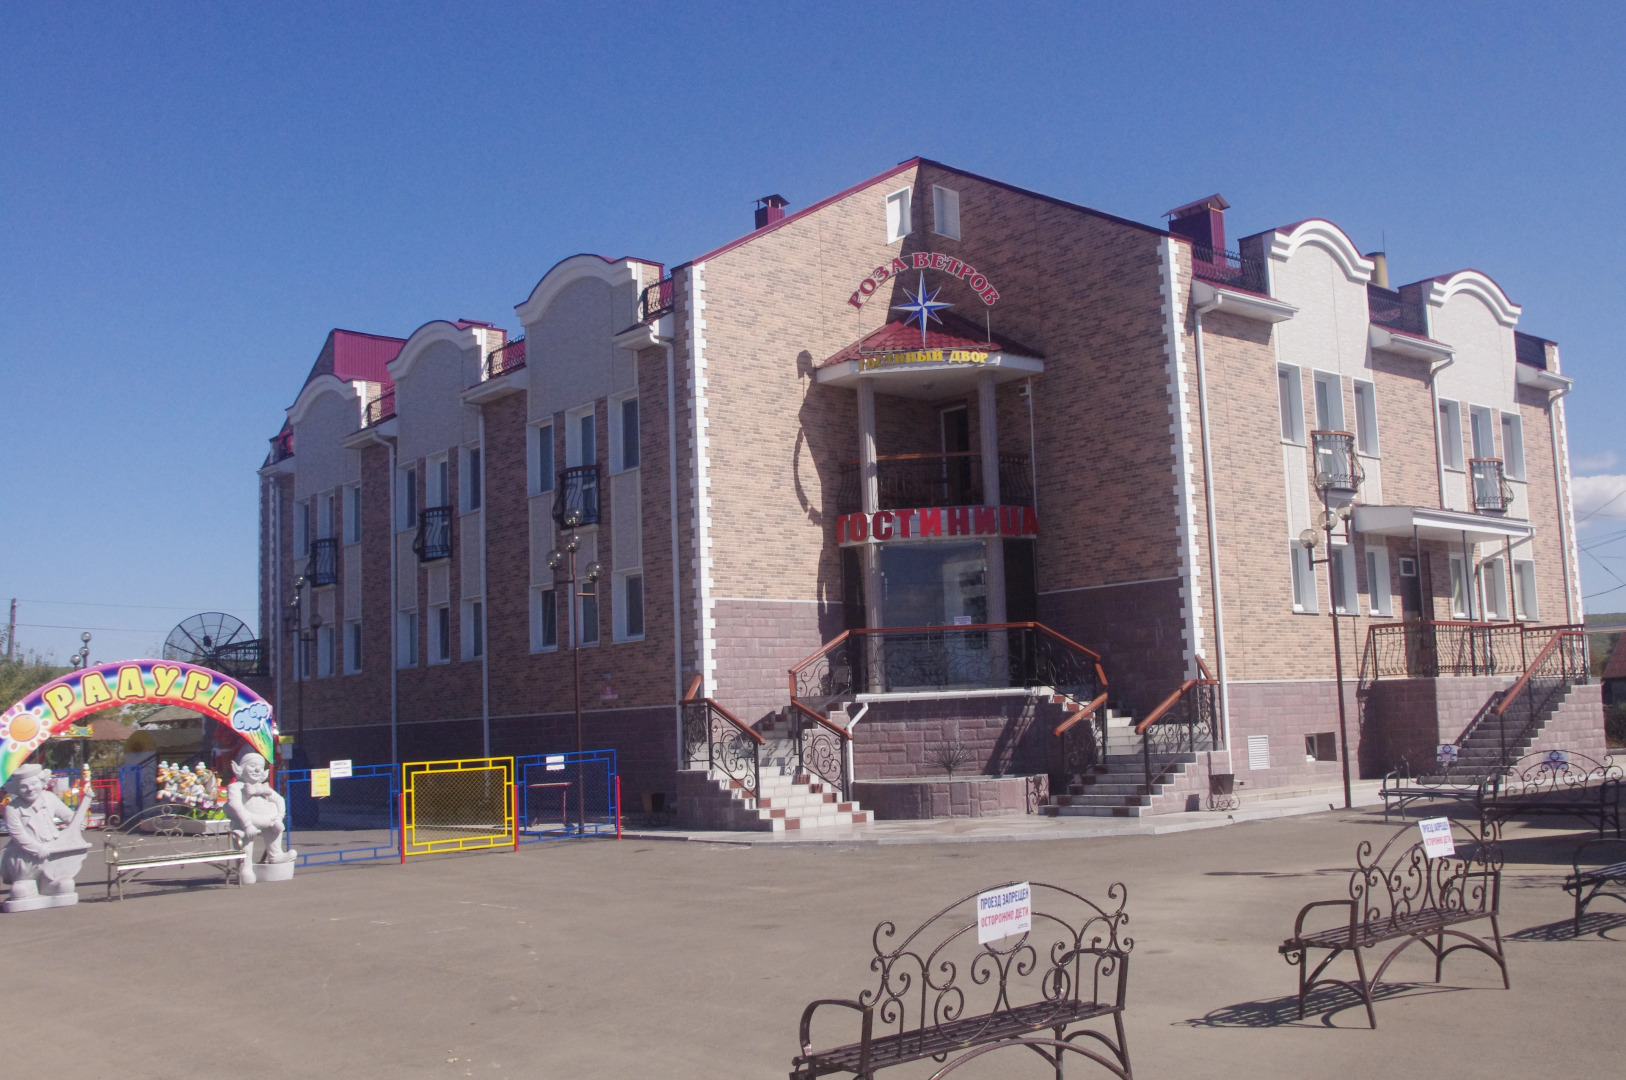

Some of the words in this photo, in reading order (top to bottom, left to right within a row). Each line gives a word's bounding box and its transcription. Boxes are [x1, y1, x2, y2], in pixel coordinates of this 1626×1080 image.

[848, 257, 908, 310] РОЗА
[912, 252, 1000, 305] ВЕТРОВ
[859, 349, 943, 371] ГОСТИННЫЙ
[948, 350, 989, 363] ДВОР
[836, 506, 1039, 543] ГОСТИНИЦА
[43, 664, 238, 721] РАДУГА
[980, 894, 1001, 910] ПРОЕЗД
[1002, 888, 1029, 906] ЗАПРЕЩЕН
[980, 910, 1014, 928] ОСТОРОЖНО
[1015, 906, 1029, 920] ДЕТИ
